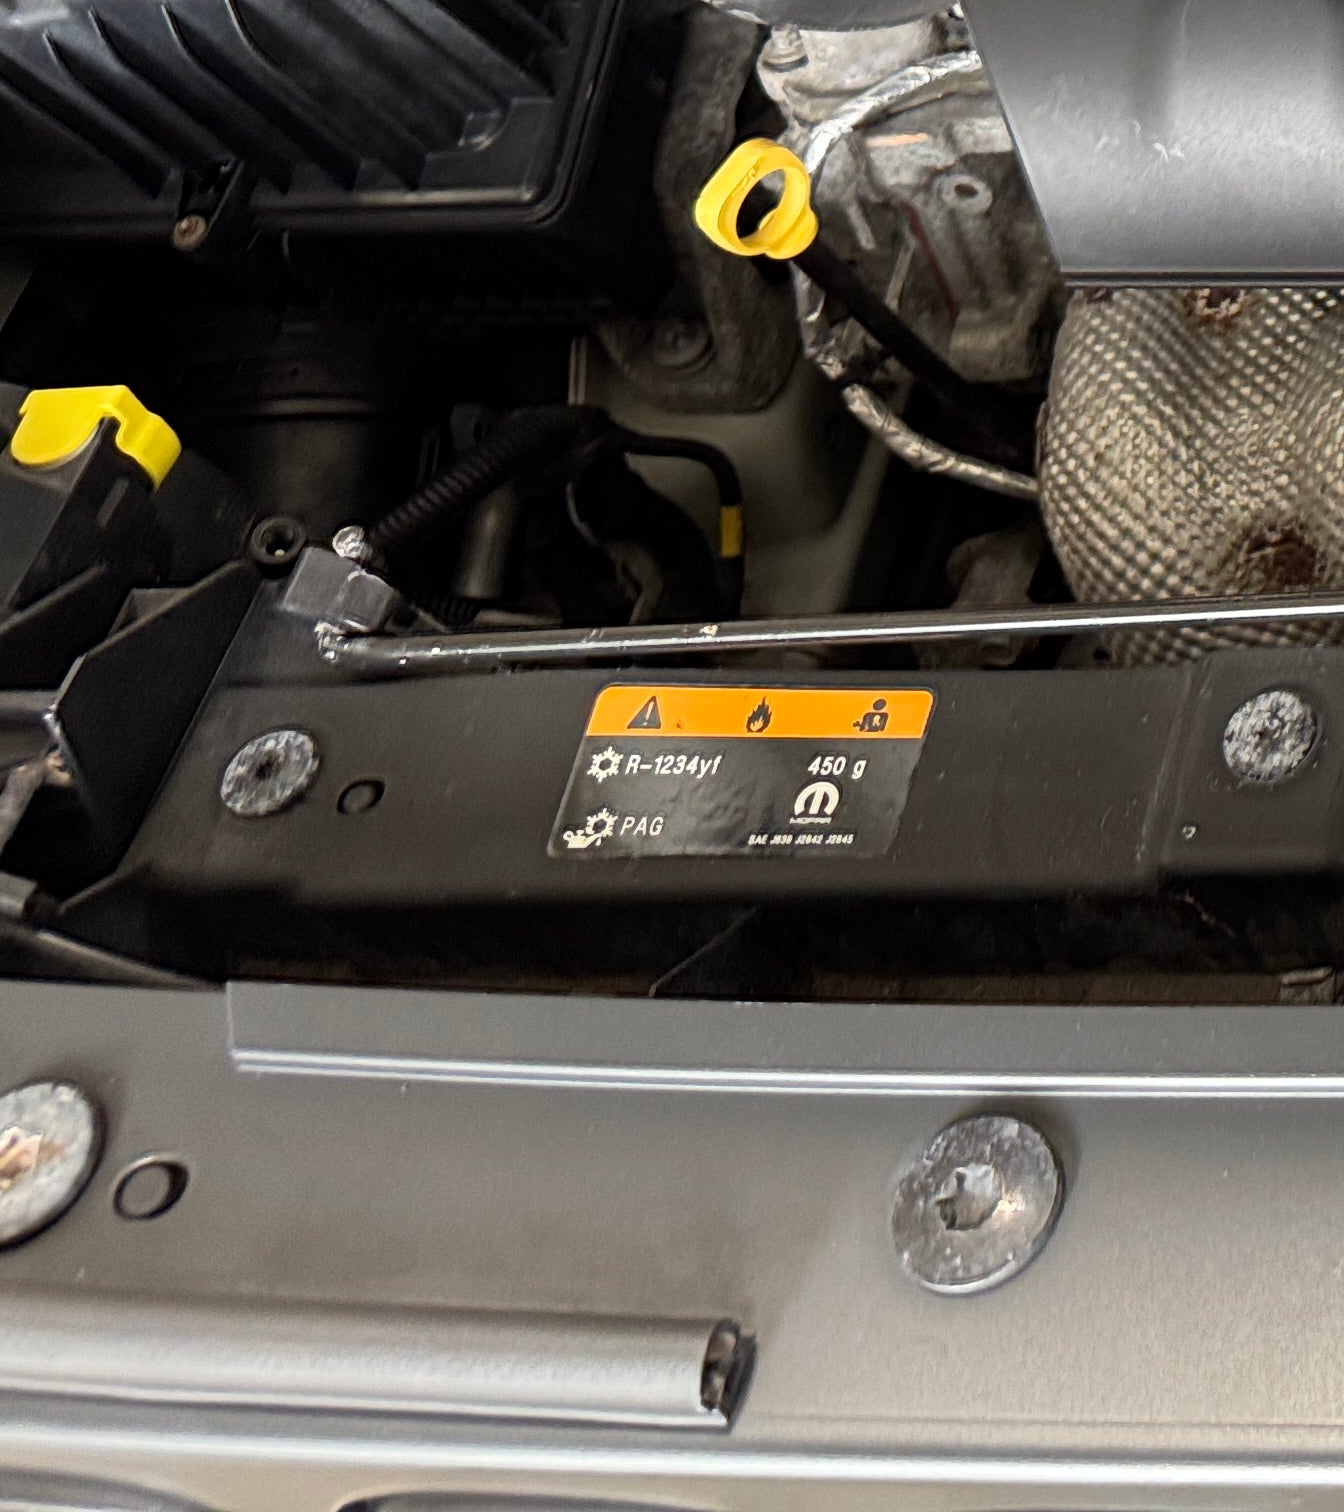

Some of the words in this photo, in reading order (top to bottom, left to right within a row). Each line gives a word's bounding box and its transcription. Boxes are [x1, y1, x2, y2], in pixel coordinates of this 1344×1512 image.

[624, 753, 724, 779] R-1234yf
[808, 755, 847, 776] 450
[851, 759, 868, 780] g
[619, 816, 664, 837] PAG
